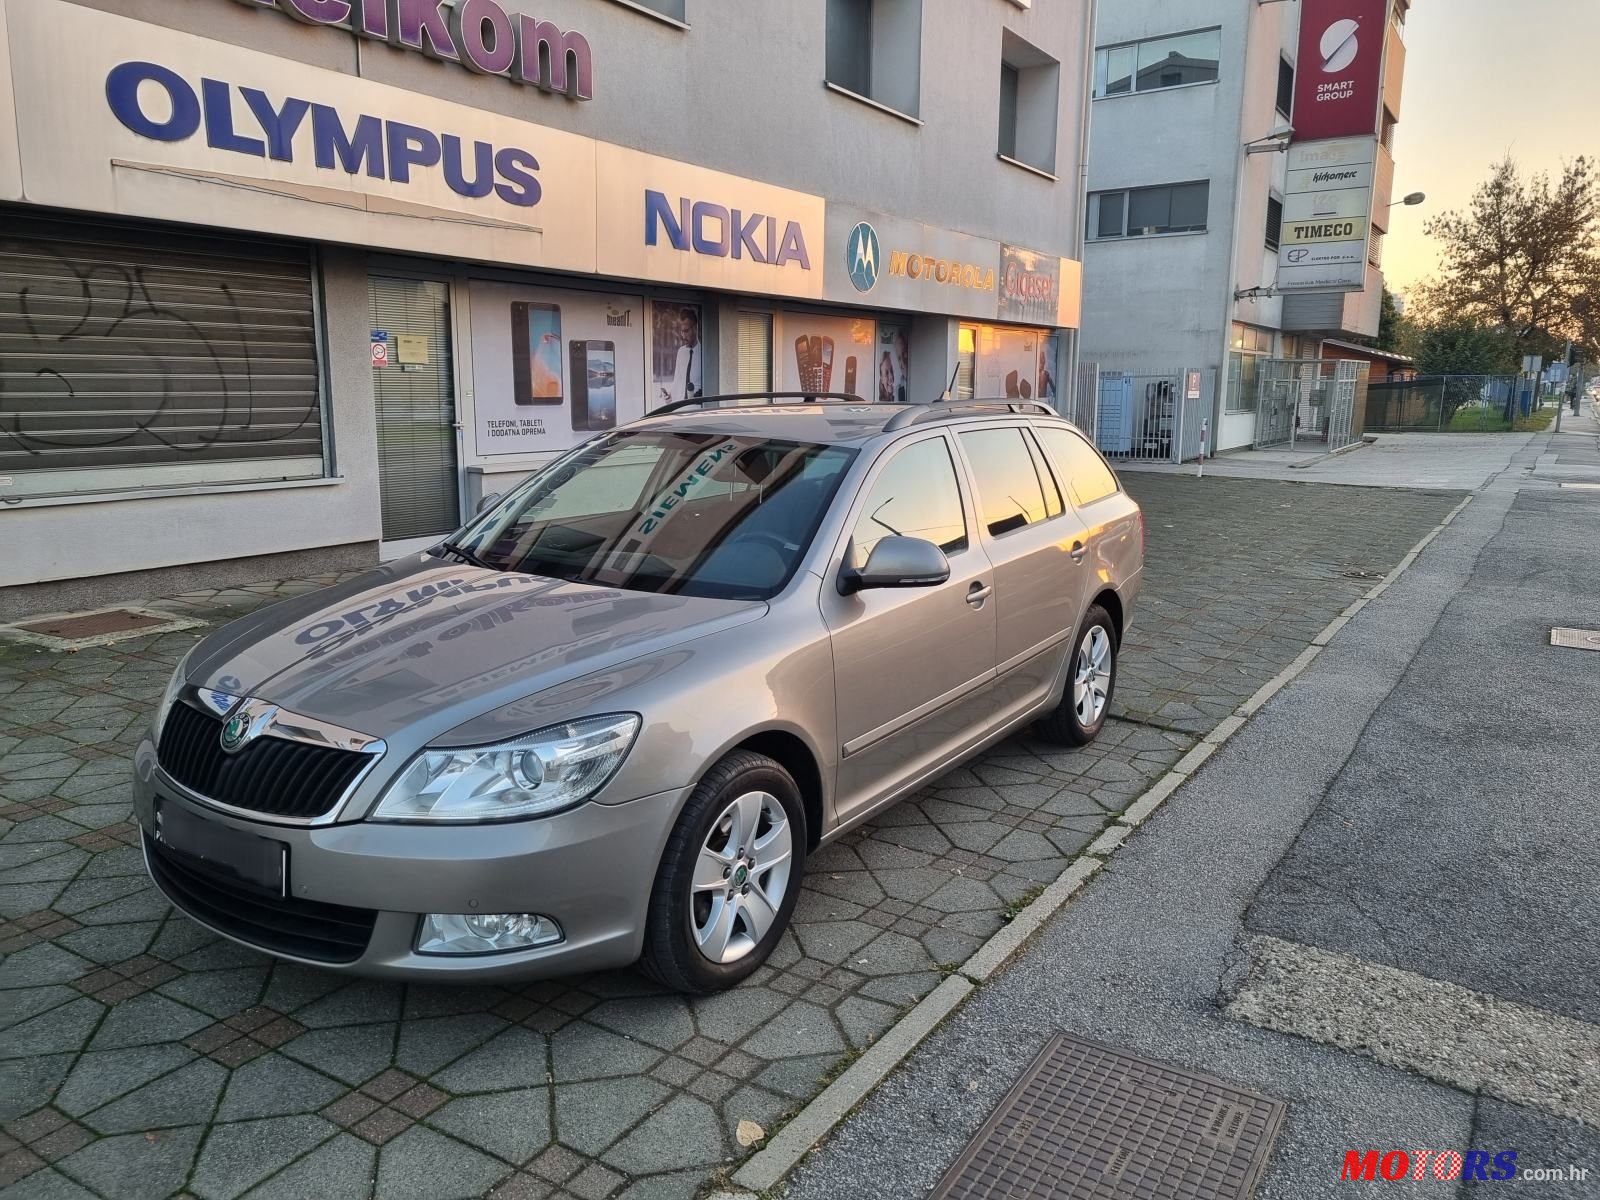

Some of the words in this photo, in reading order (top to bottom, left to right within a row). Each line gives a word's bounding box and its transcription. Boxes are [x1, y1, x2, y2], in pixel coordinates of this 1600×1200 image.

[1317, 80, 1354, 92] SMART
[1316, 90, 1353, 101] GROUP
[105, 61, 542, 207] OLYMPUS
[1312, 170, 1357, 182] kirkomerc
[645, 189, 811, 270] NOKIA
[1294, 222, 1353, 239] TIMECO
[888, 249, 995, 291] MOTOROLA
[519, 419, 543, 427] TABLETI
[491, 428, 520, 437] DODATNA
[521, 427, 546, 436] OPREMA
